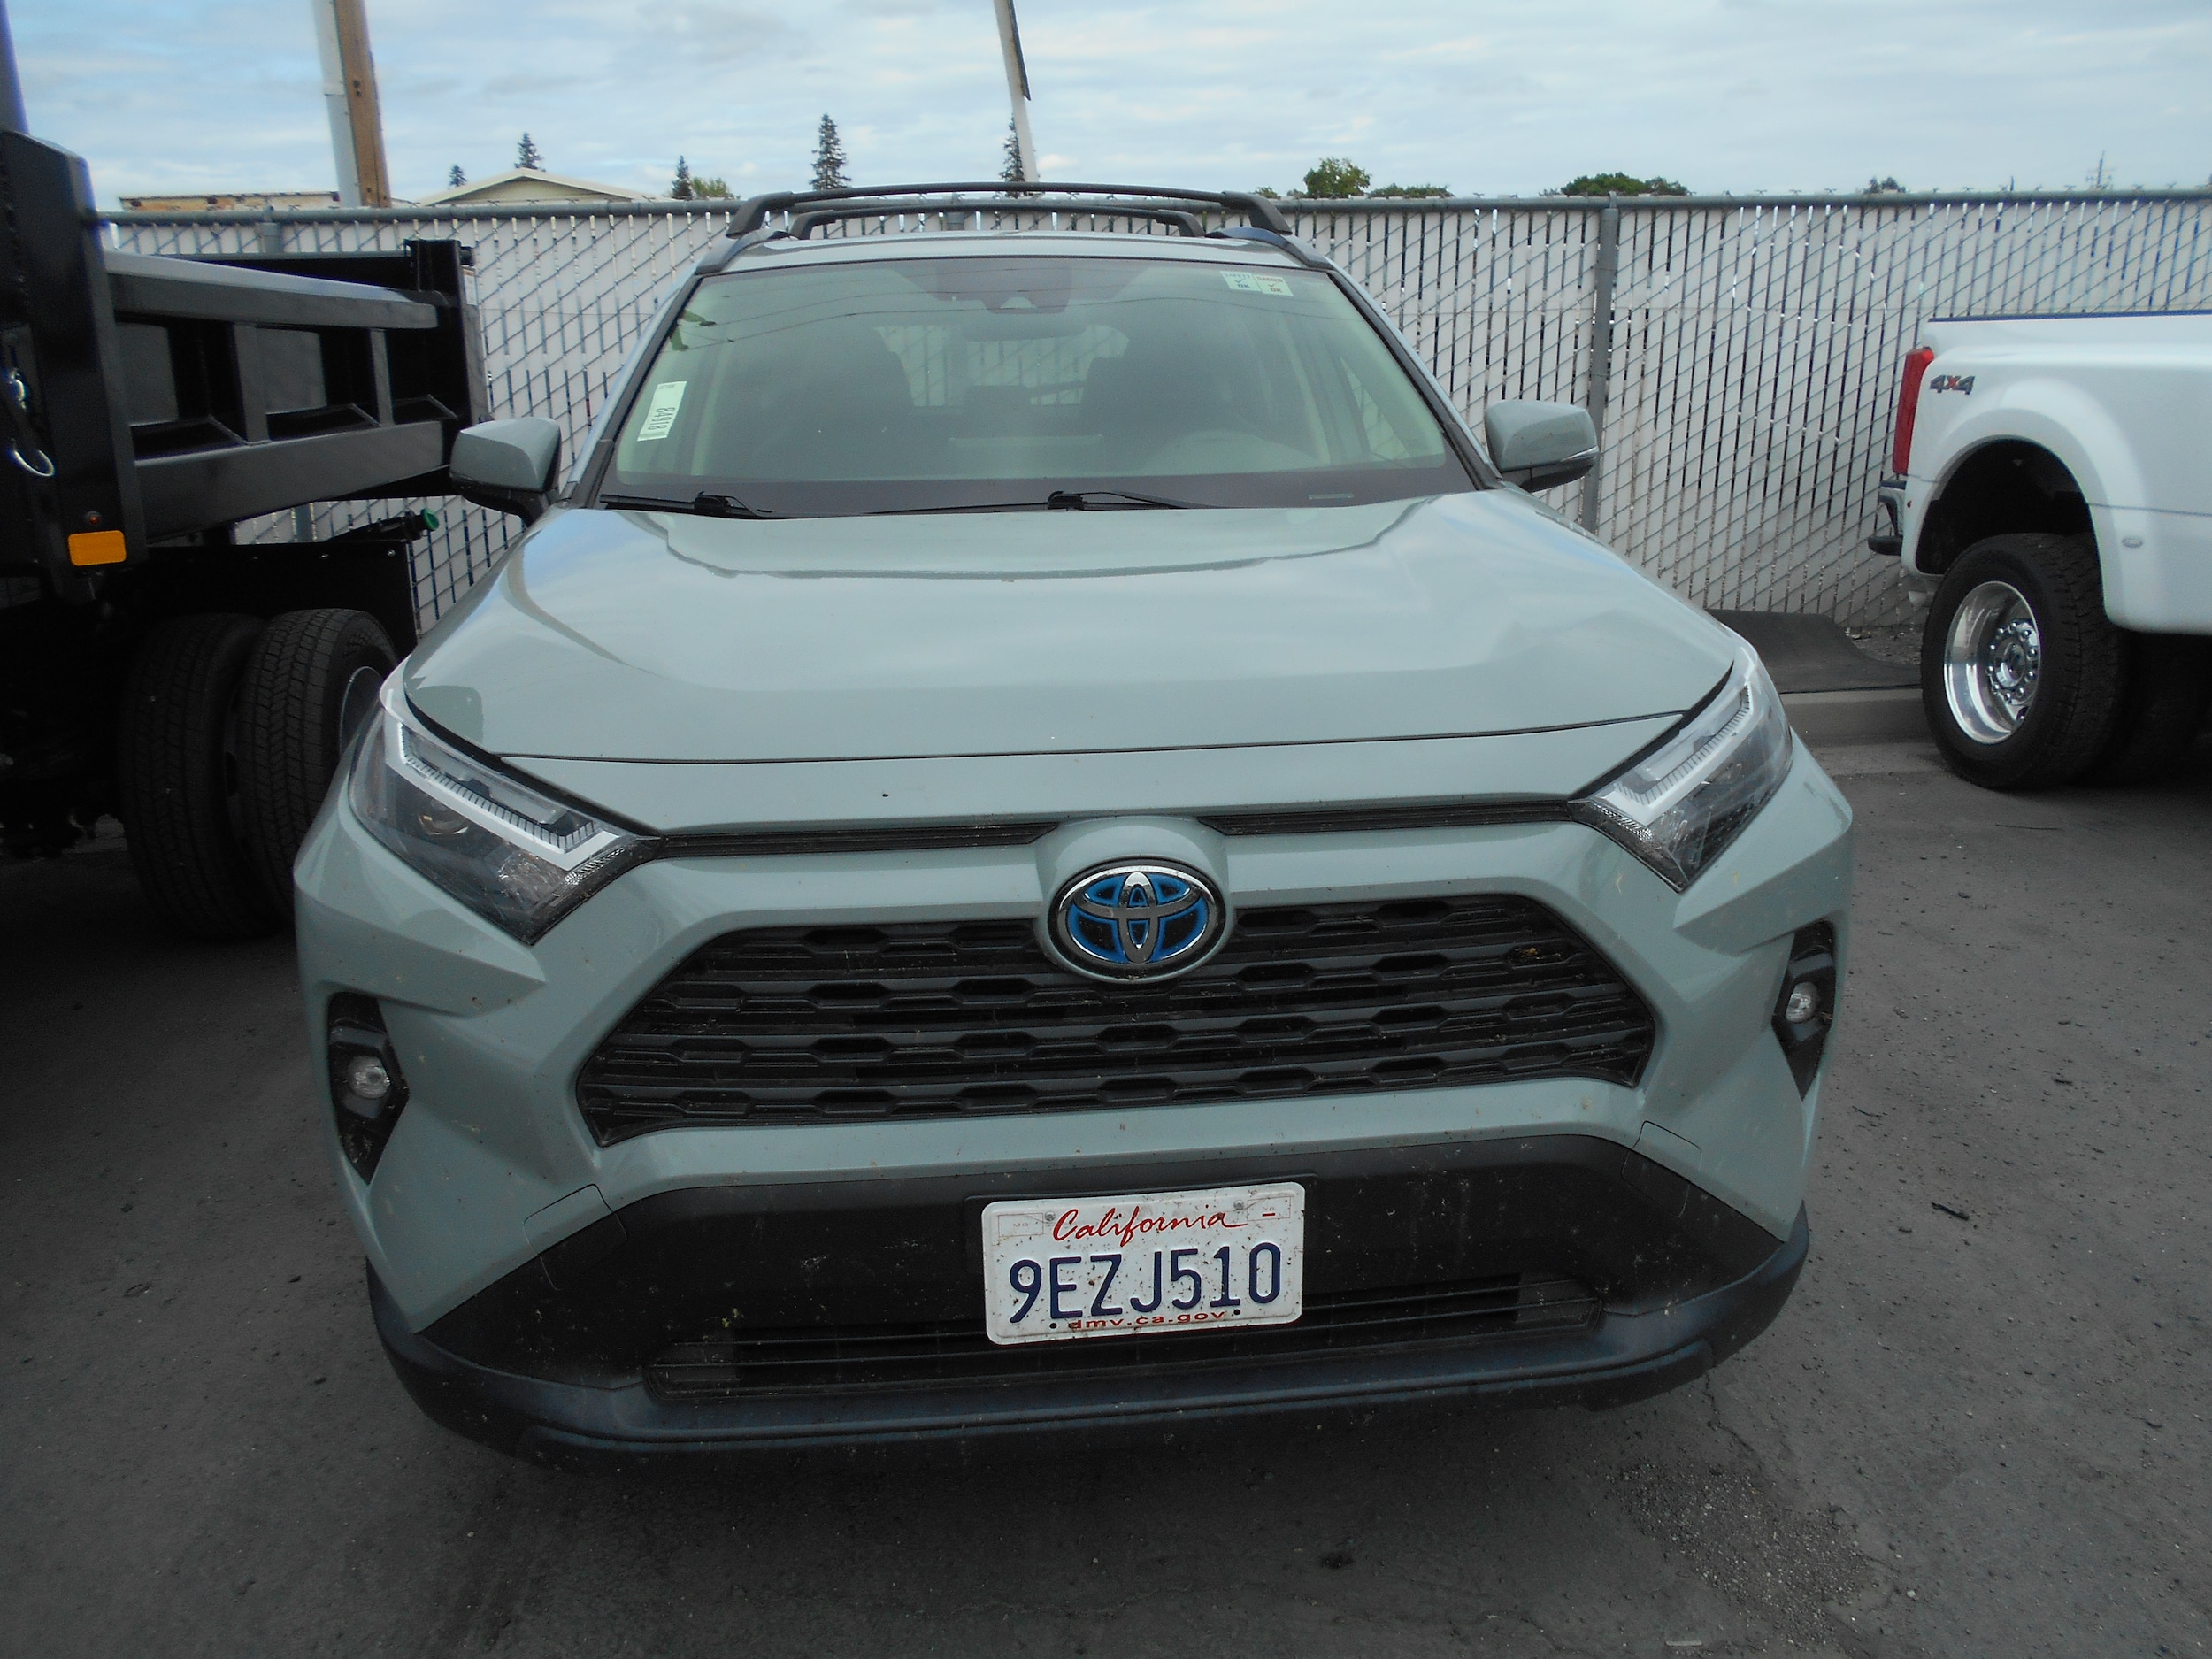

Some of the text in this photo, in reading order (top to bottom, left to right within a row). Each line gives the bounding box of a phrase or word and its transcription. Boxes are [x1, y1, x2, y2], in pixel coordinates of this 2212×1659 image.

[1053, 1204, 1248, 1248] California
[1009, 1241, 1282, 1324] 9EZJ510
[1068, 1310, 1226, 1331] dmv.ca.gov
